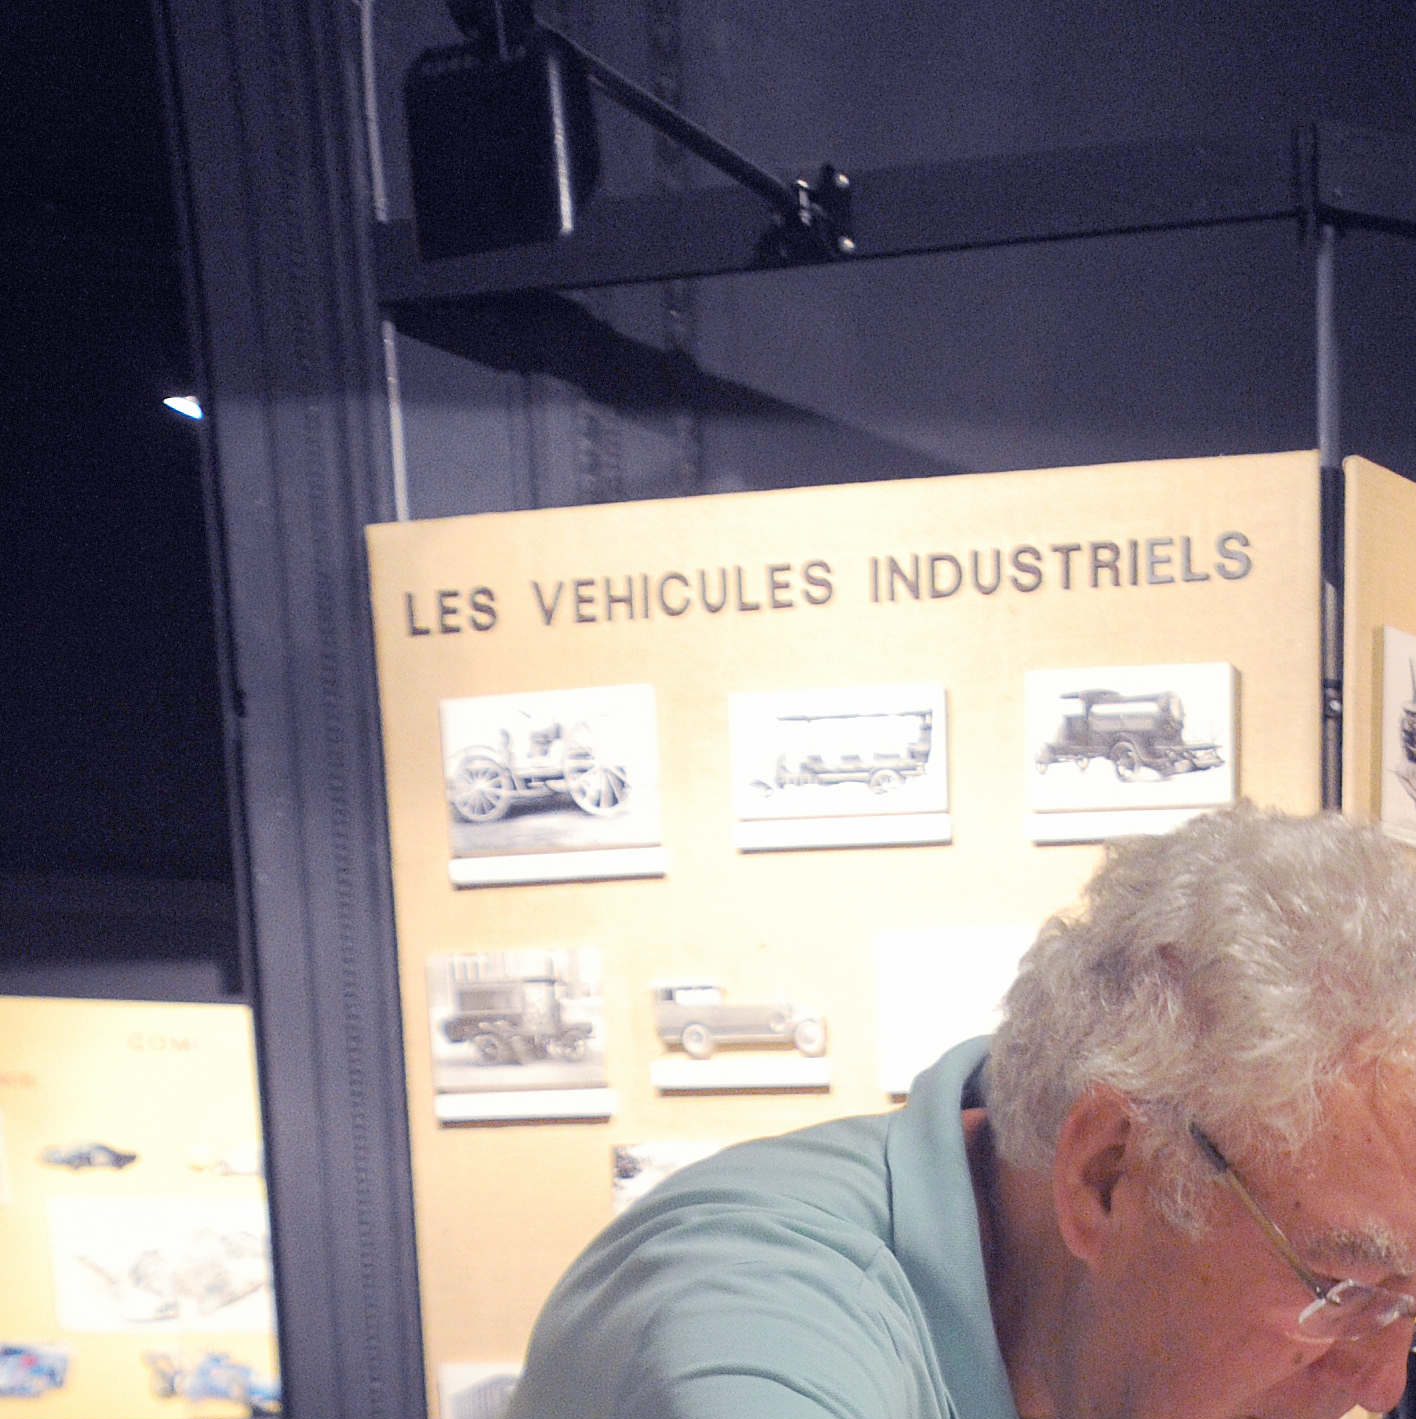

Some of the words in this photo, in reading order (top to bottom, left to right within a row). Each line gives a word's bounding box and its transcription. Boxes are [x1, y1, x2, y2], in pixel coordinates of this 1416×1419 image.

[405, 587, 498, 637] LES
[531, 558, 835, 626] VEHICULES
[869, 530, 1253, 604] INDUSTRIELS
